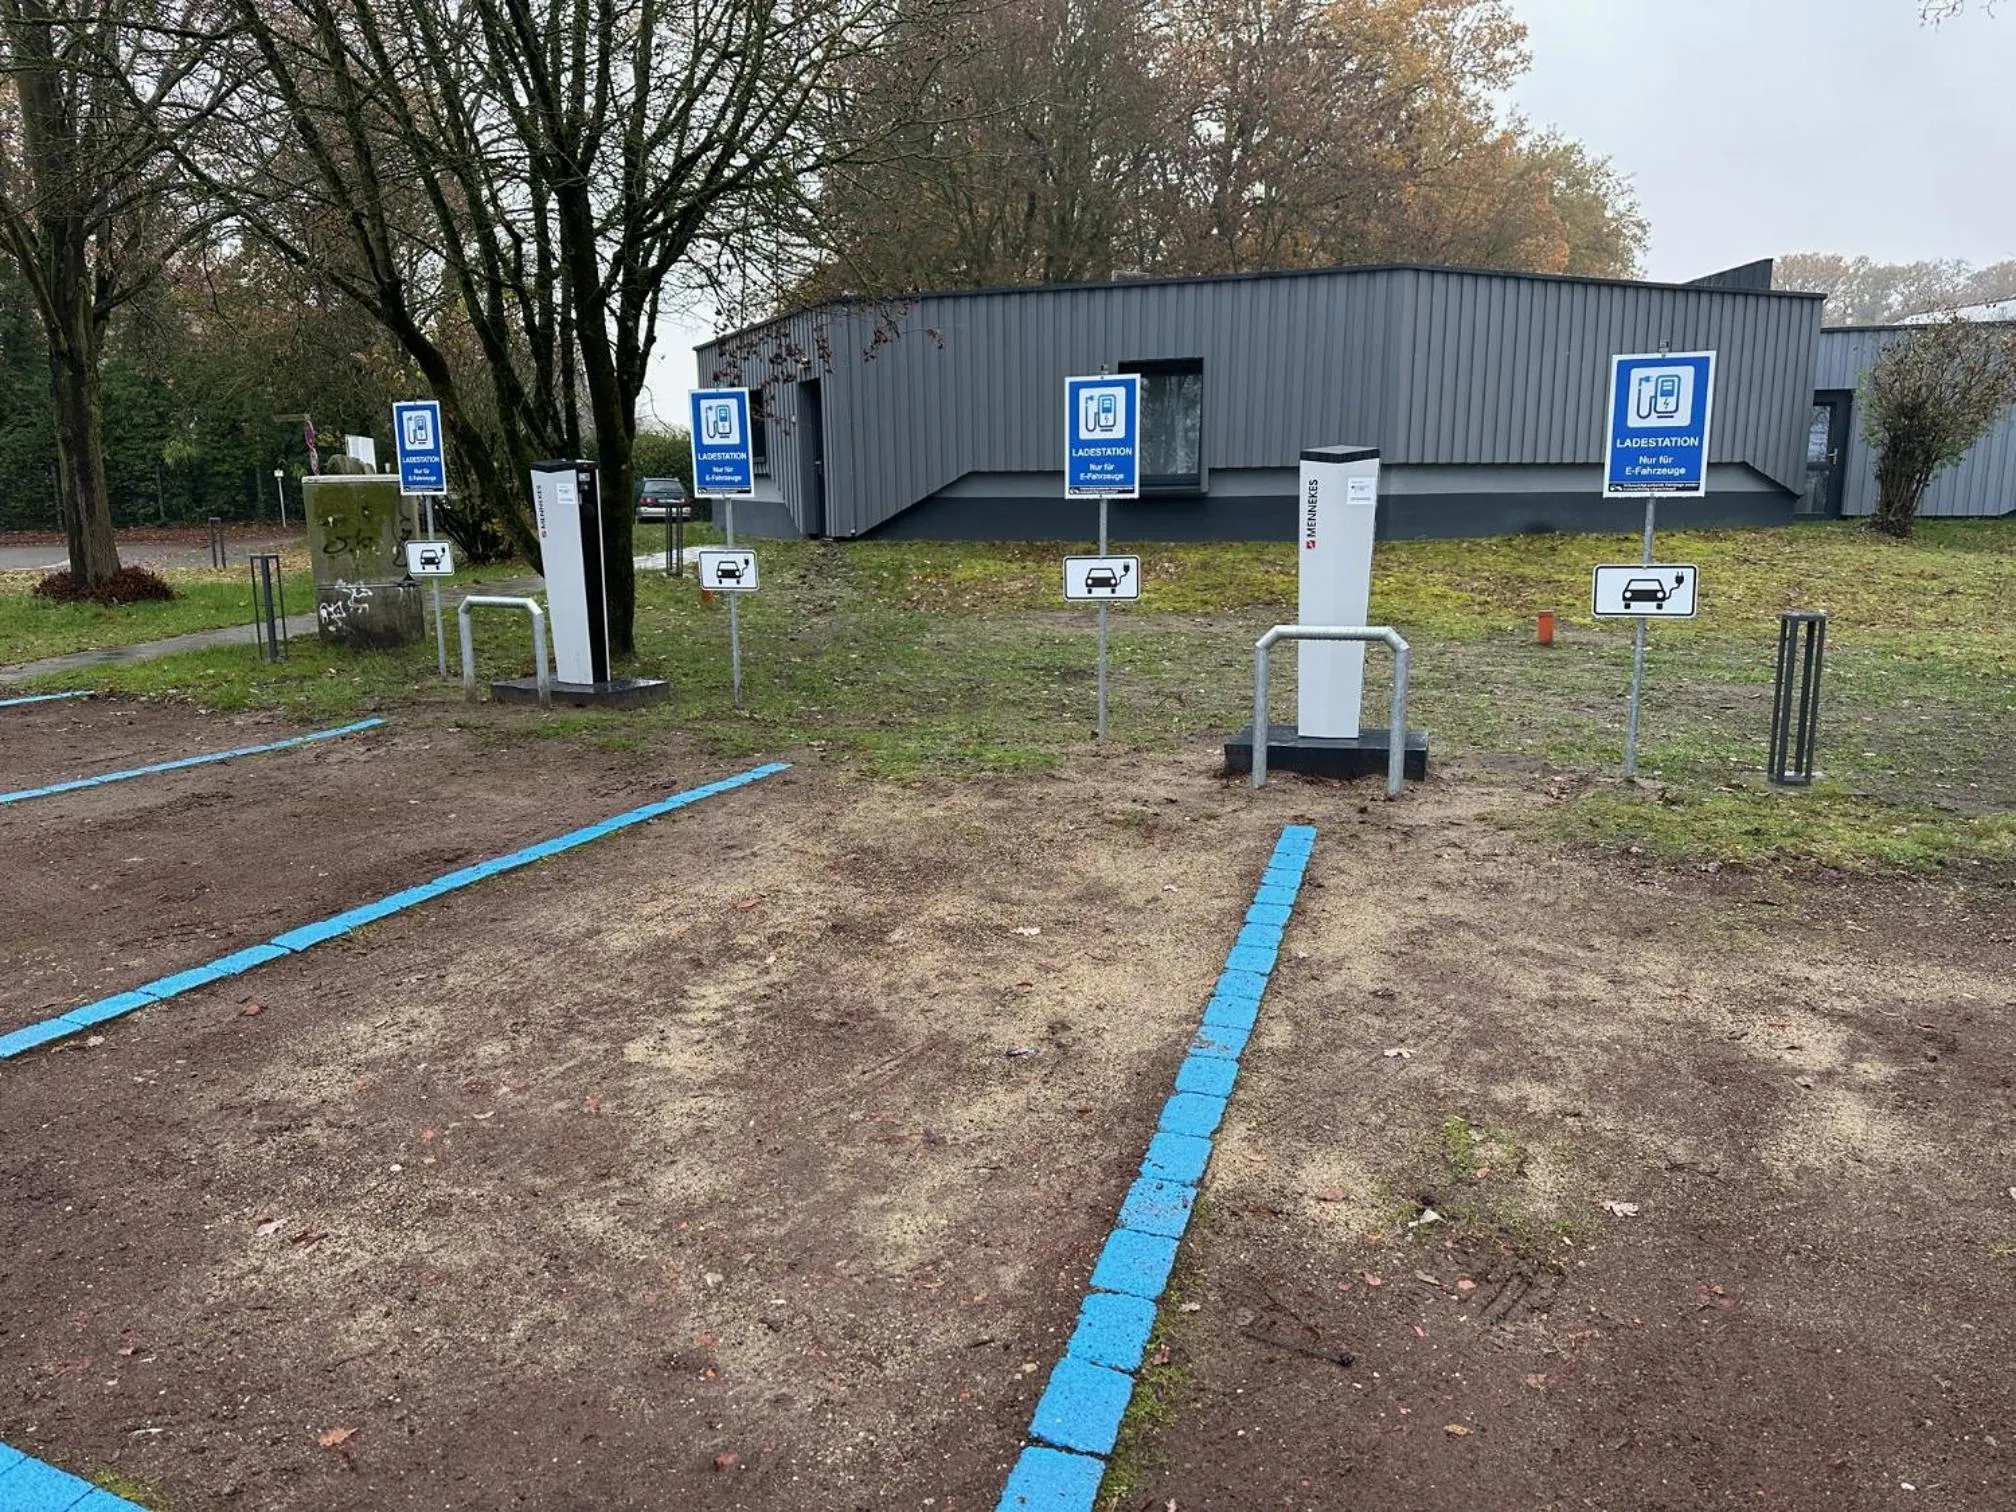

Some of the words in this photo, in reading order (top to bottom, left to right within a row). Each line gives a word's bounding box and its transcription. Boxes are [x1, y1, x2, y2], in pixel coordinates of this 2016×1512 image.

[1616, 436, 1699, 448] LADESTATION
[698, 452, 746, 460] LADESTATION
[1072, 447, 1132, 456] LADESTATION
[1639, 456, 1656, 464] Nur
[1659, 455, 1674, 464] für
[1089, 463, 1102, 471] Nur
[1104, 462, 1115, 471] für
[1625, 466, 1686, 476] E-Fahrzeuge
[1080, 472, 1124, 481] E-Fahrzeuge
[1307, 479, 1318, 537] MENNEKES
